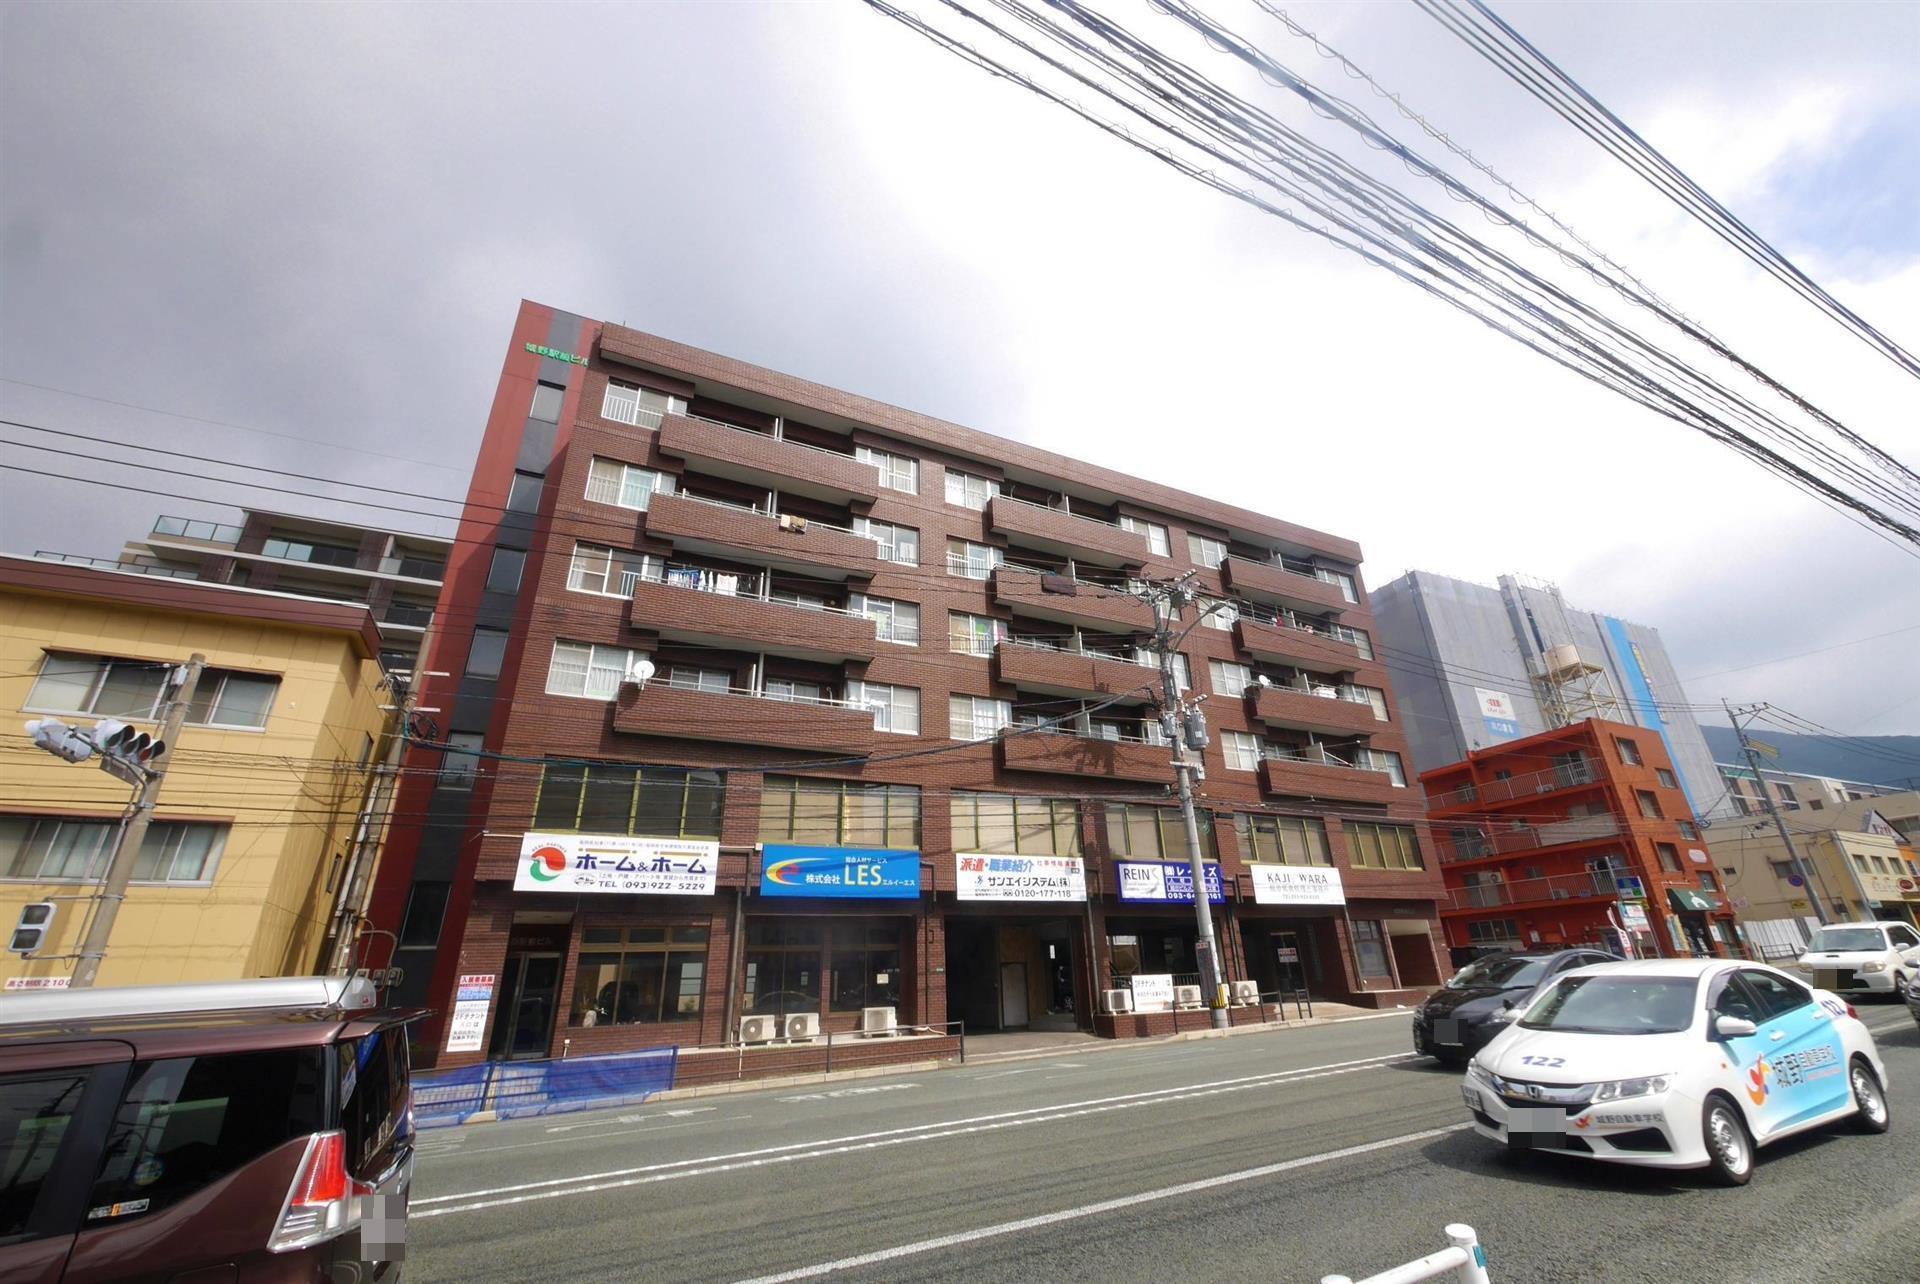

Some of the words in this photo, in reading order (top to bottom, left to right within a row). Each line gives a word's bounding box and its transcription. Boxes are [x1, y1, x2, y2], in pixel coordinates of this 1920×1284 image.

[805, 873, 840, 885] 株式会社
[844, 864, 882, 887] LES
[1267, 872, 1291, 883] KAJI
[1298, 873, 1328, 885] WARA
[598, 880, 618, 888] TEL
[1820, 999, 1846, 1017] 122
[1521, 1055, 1566, 1068] 122
